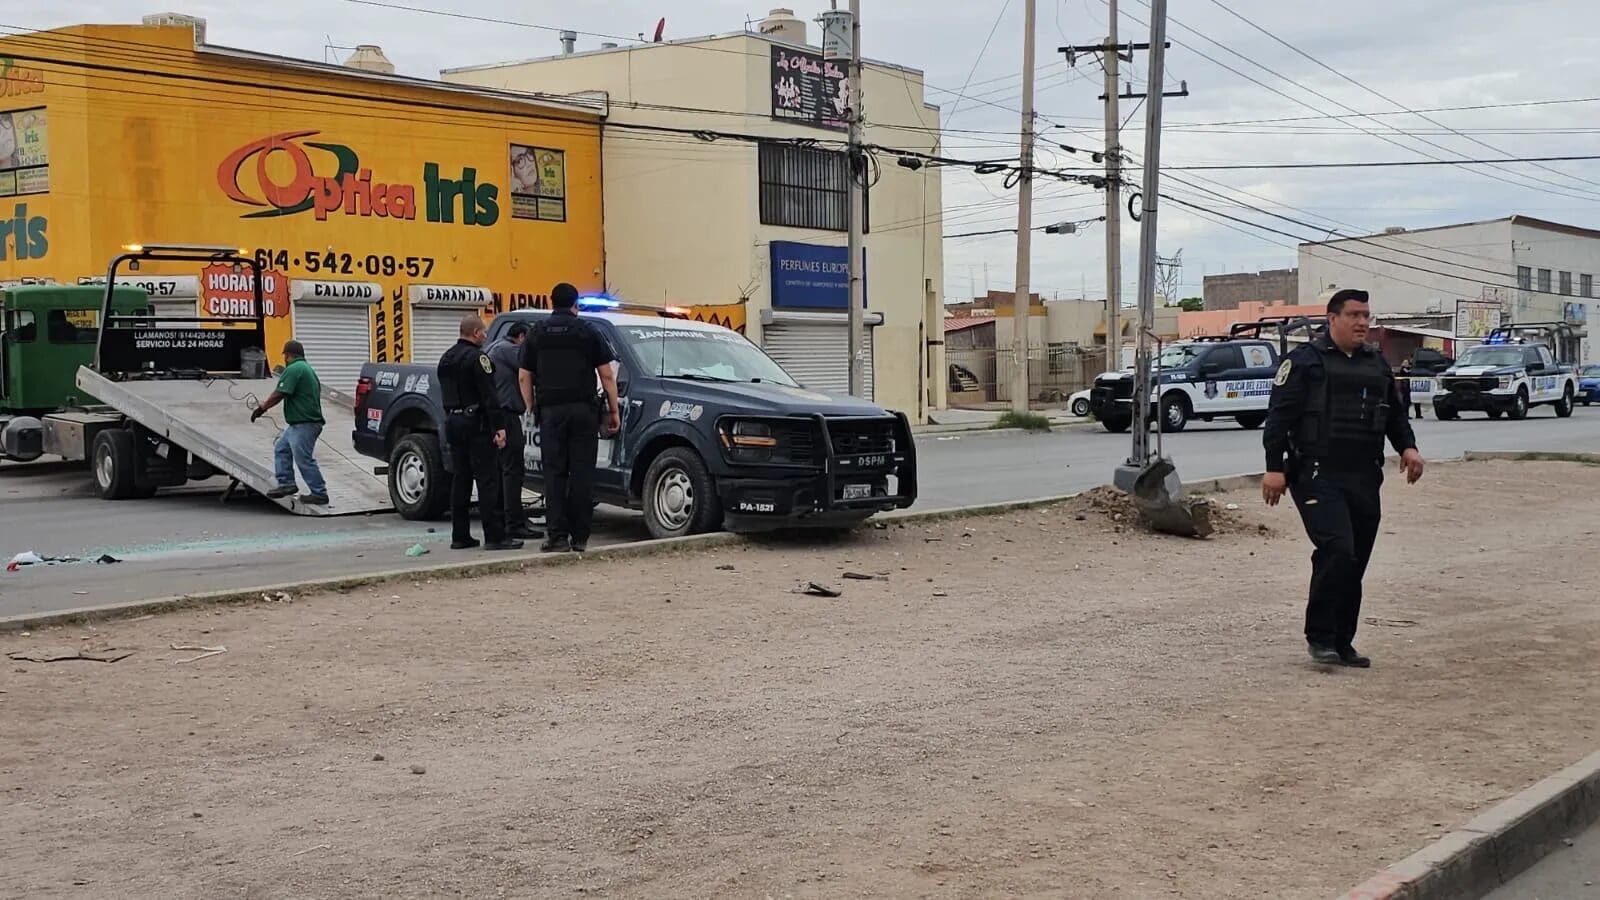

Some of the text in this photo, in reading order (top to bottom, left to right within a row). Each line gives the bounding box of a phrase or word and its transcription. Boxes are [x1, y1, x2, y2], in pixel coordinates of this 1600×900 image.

[424, 162, 499, 226] Iris
[780, 259, 820, 273] PERFUMES
[314, 283, 373, 299] CALIDAD
[426, 287, 486, 303] GARANTIA
[135, 340, 224, 348] SERVICIO LAS 24 HORAS
[858, 455, 886, 466] DSPM
